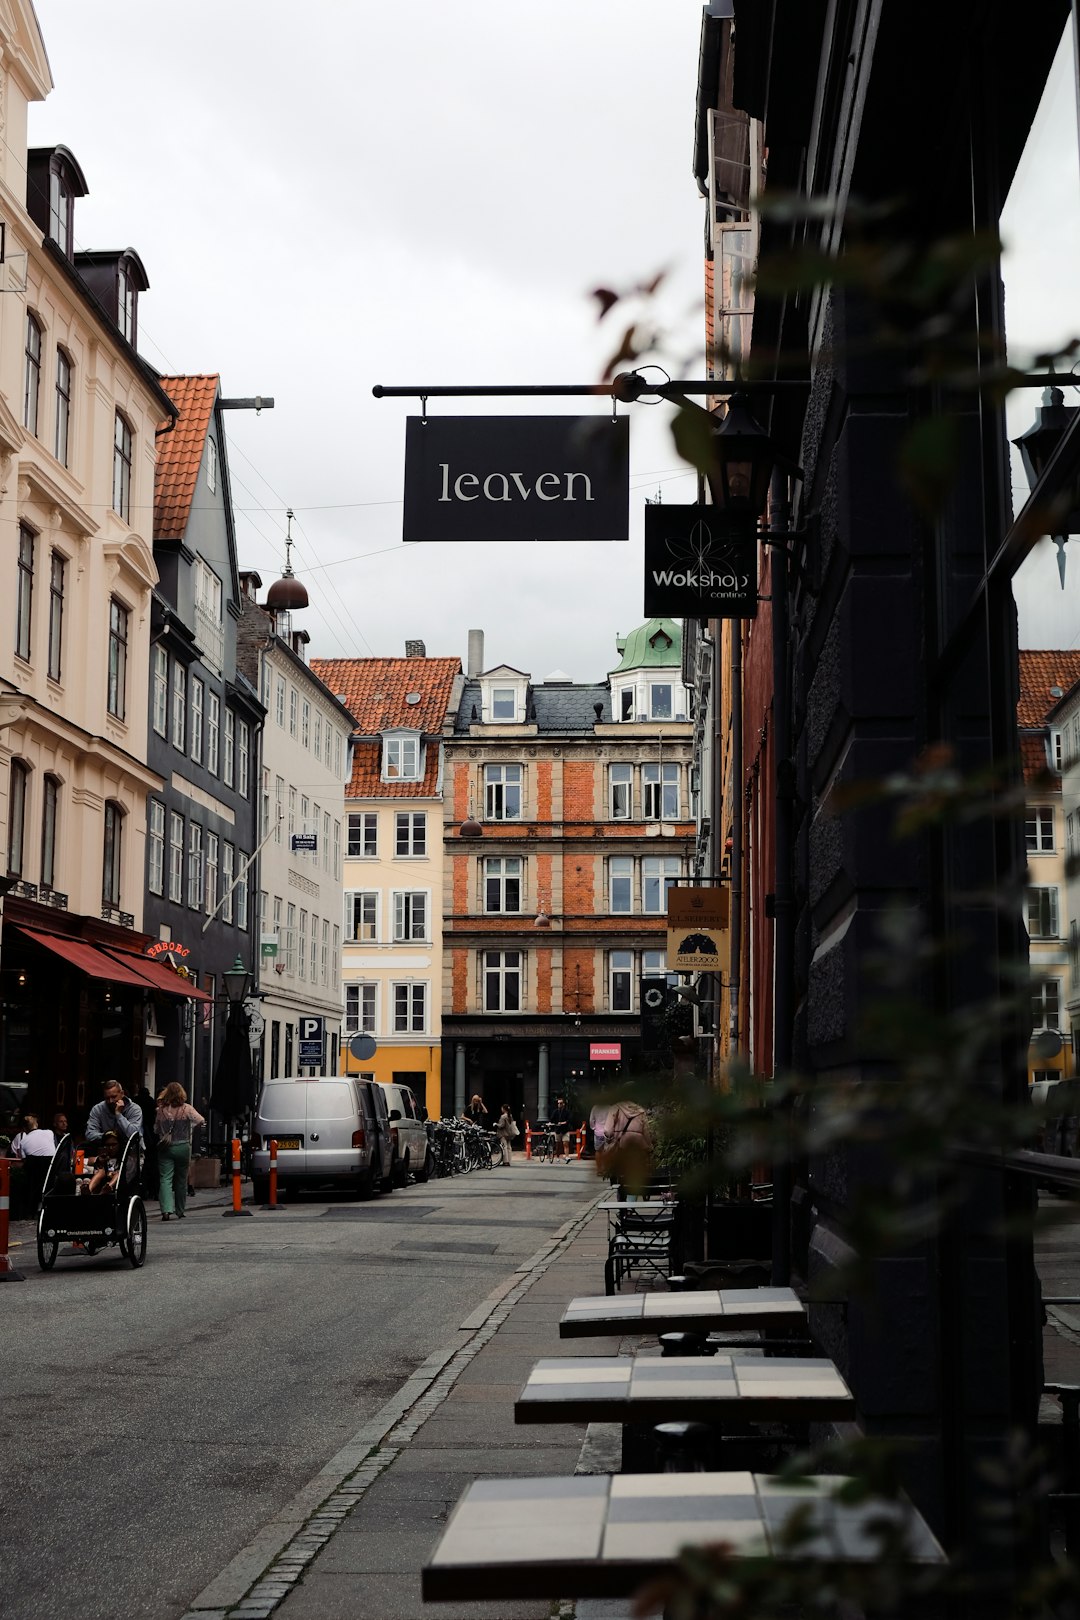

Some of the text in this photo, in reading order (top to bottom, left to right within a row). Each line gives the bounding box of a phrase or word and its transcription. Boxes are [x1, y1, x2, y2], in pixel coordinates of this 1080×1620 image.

[438, 463, 595, 502] leaven
[652, 569, 748, 592] Wokshop
[304, 1020, 318, 1038] P
